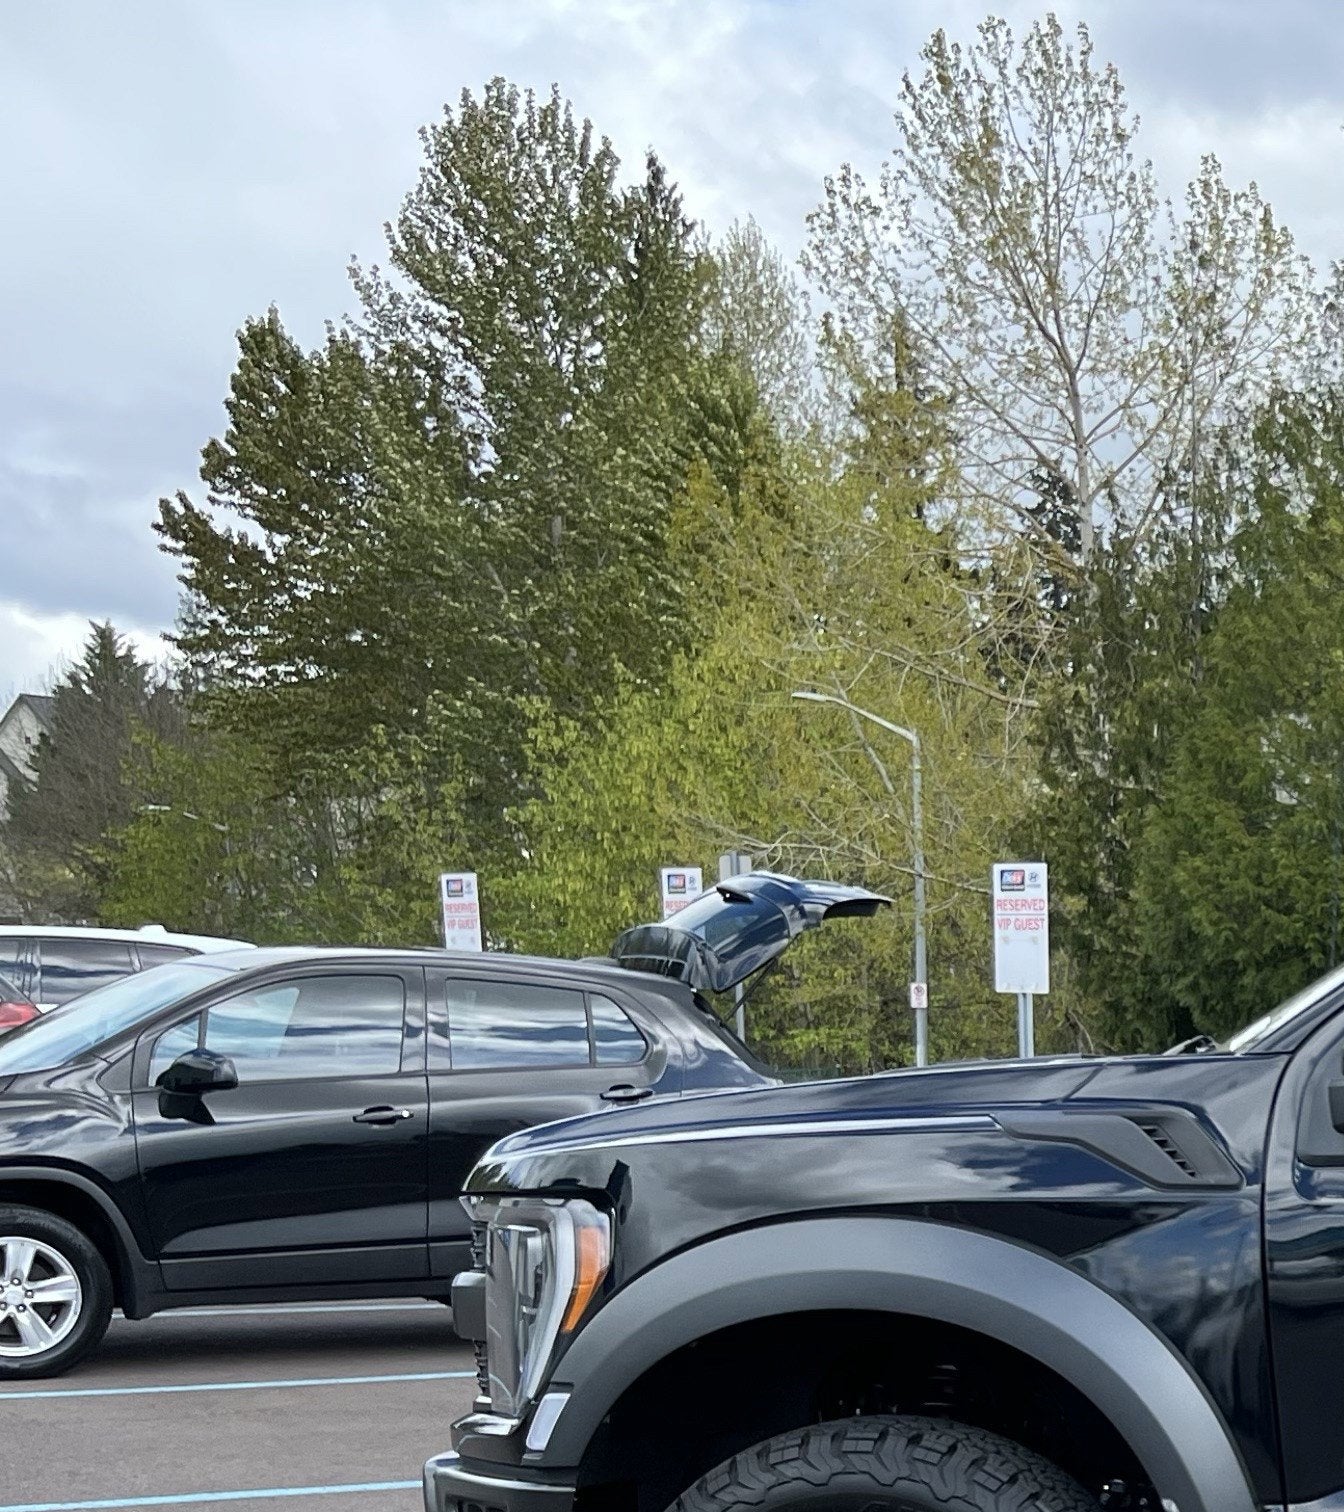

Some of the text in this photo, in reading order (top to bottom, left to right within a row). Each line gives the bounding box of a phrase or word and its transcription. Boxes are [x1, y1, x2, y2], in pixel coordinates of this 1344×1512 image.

[997, 899, 1046, 911] RESERVED
[997, 918, 1045, 931] VIP GUEST
